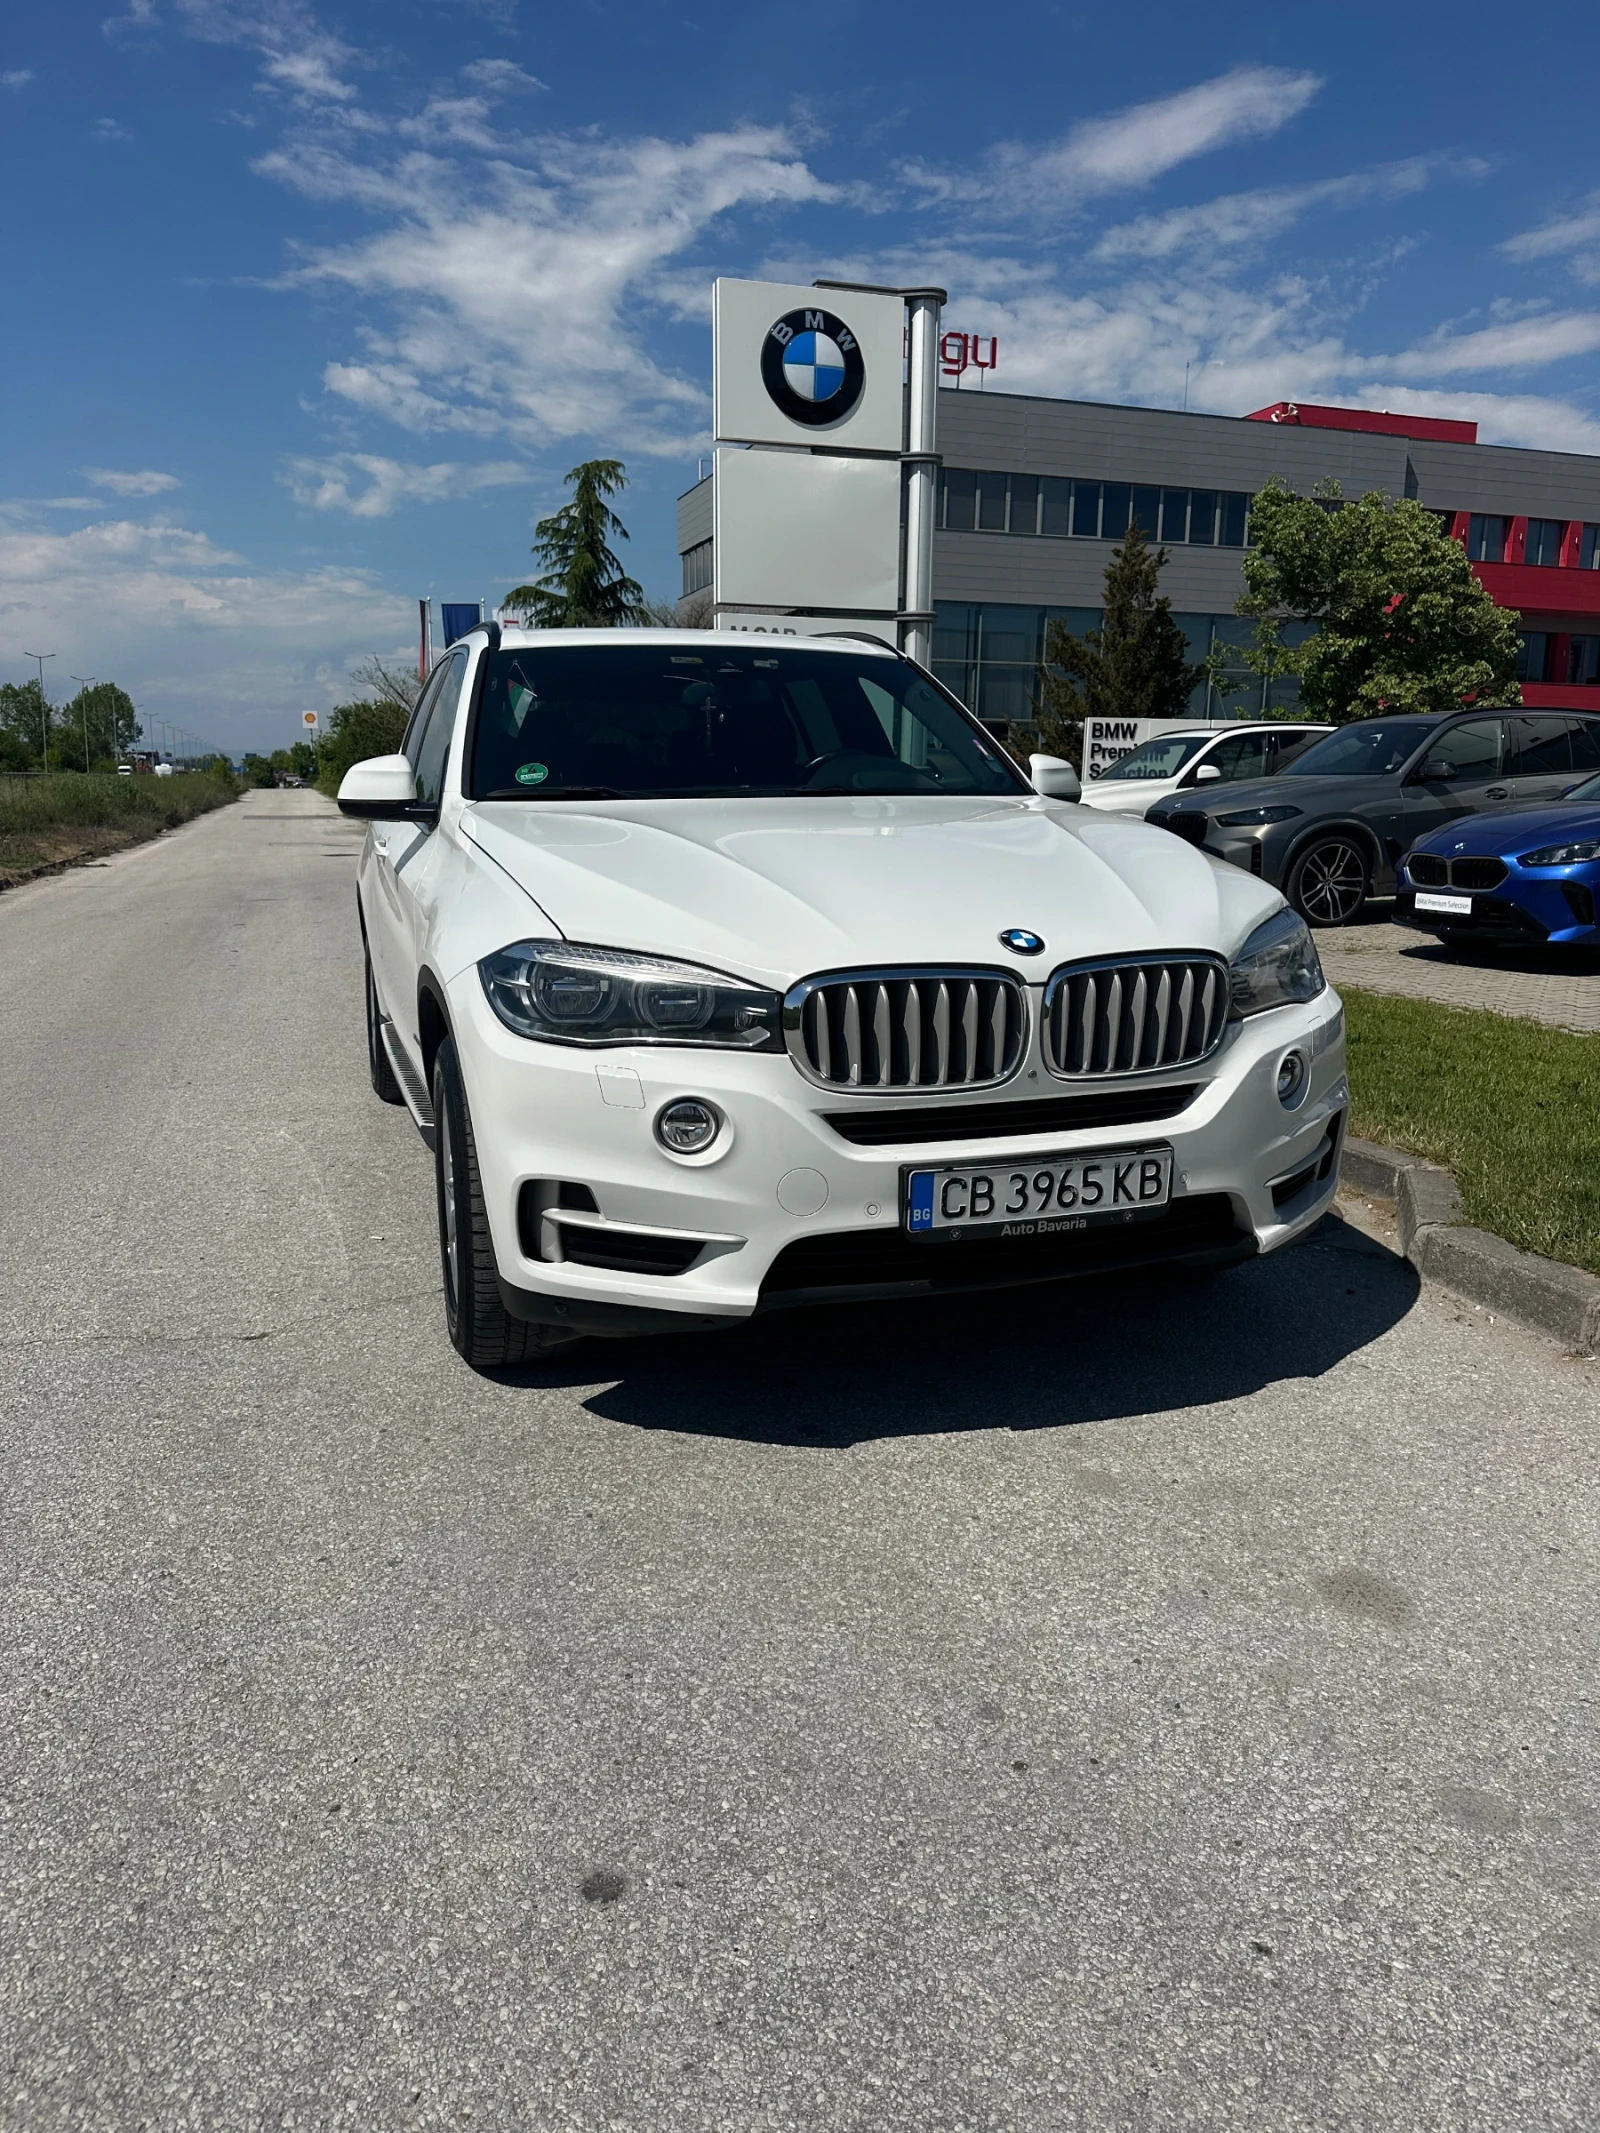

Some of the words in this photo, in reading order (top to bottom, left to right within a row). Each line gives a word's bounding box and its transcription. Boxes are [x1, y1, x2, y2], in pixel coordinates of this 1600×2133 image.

[772, 311, 857, 351] BMW
[1091, 722, 1138, 740] BMW
[941, 1175, 996, 1219] CB
[1005, 1165, 1104, 1214] 3965
[1112, 1159, 1163, 1203] KB
[913, 1208, 931, 1221] BG
[1001, 1223, 1034, 1236] Auto
[1037, 1217, 1087, 1232] Bavaria
